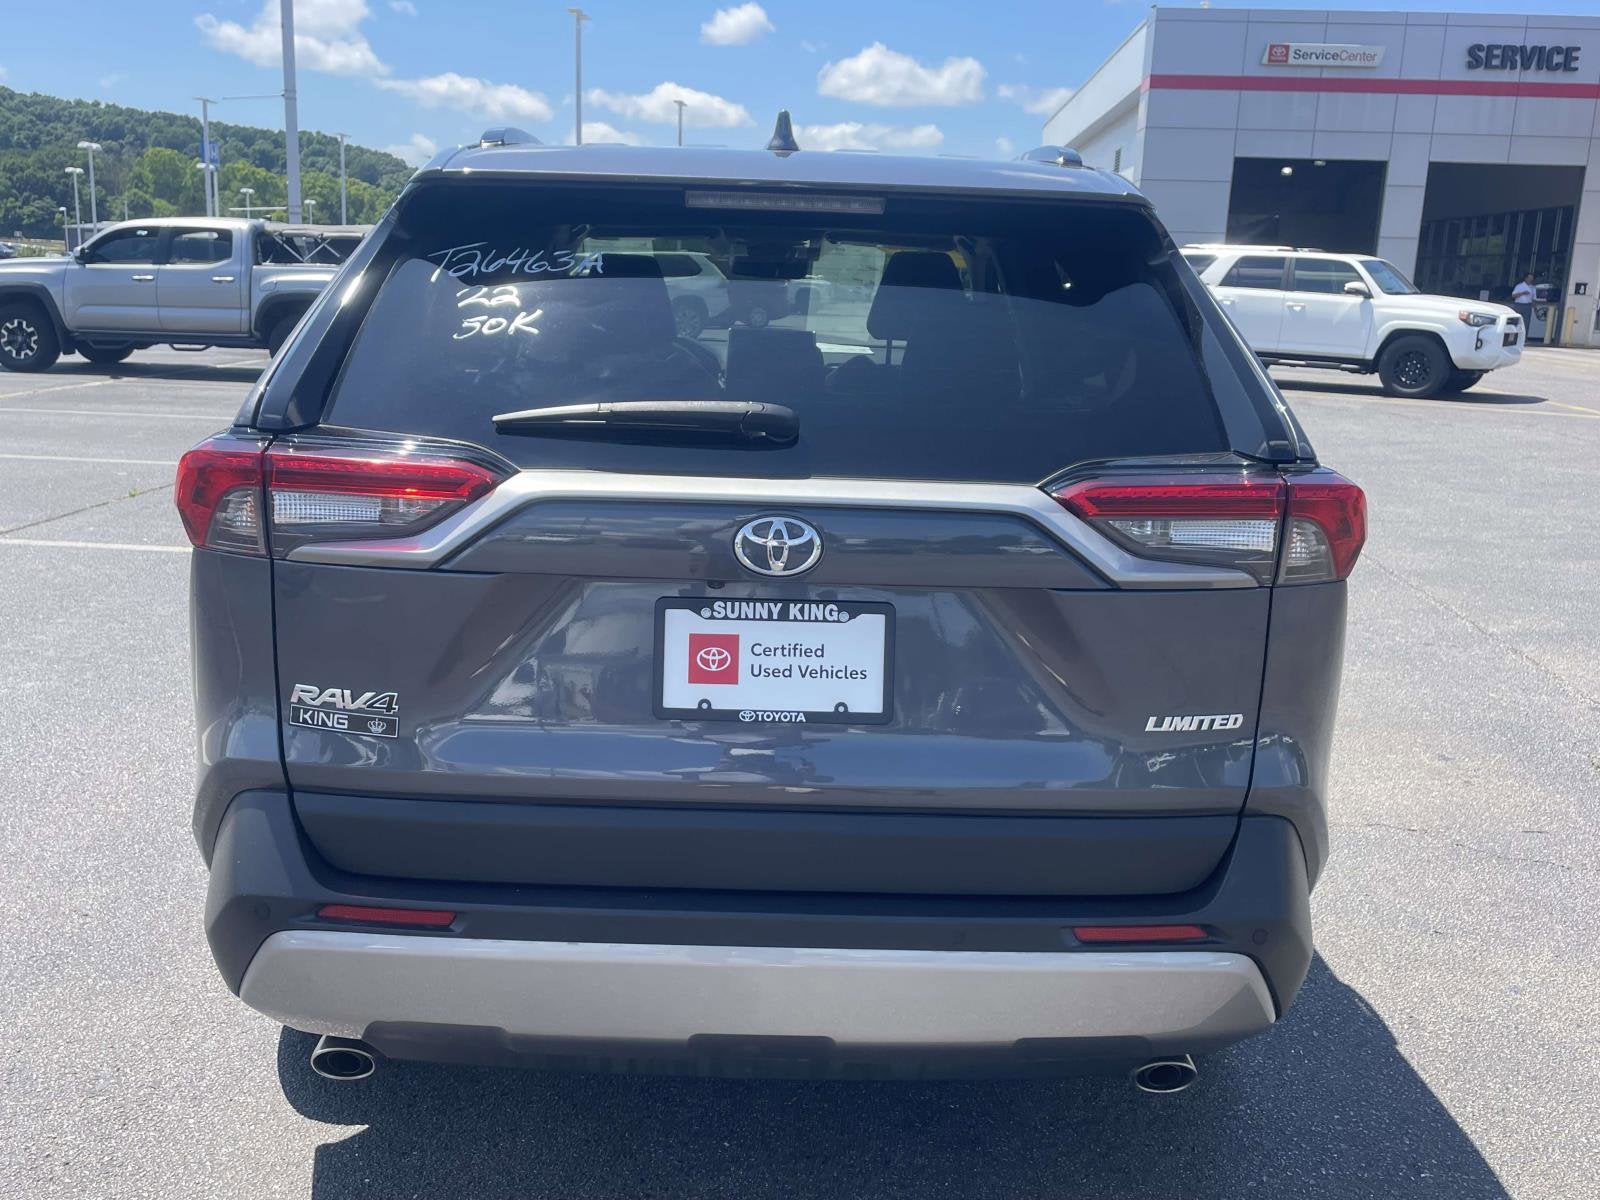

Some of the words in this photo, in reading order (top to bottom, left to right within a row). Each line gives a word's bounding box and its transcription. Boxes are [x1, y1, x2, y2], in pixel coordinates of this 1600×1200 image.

[1293, 48, 1377, 62] ServiceCenter
[1467, 43, 1581, 72] SERVICE
[428, 241, 604, 283] T26463A
[456, 285, 521, 308] 22
[453, 309, 543, 339] 50K
[713, 600, 782, 620] SUNNY
[789, 603, 838, 621] KING
[750, 642, 825, 658] Certified
[750, 664, 793, 678] Used
[798, 665, 867, 680] Vehicles
[291, 684, 399, 714] RAV4
[300, 708, 348, 729] KING
[756, 711, 806, 722] TOYOTA
[1145, 713, 1244, 732] LIMITED
